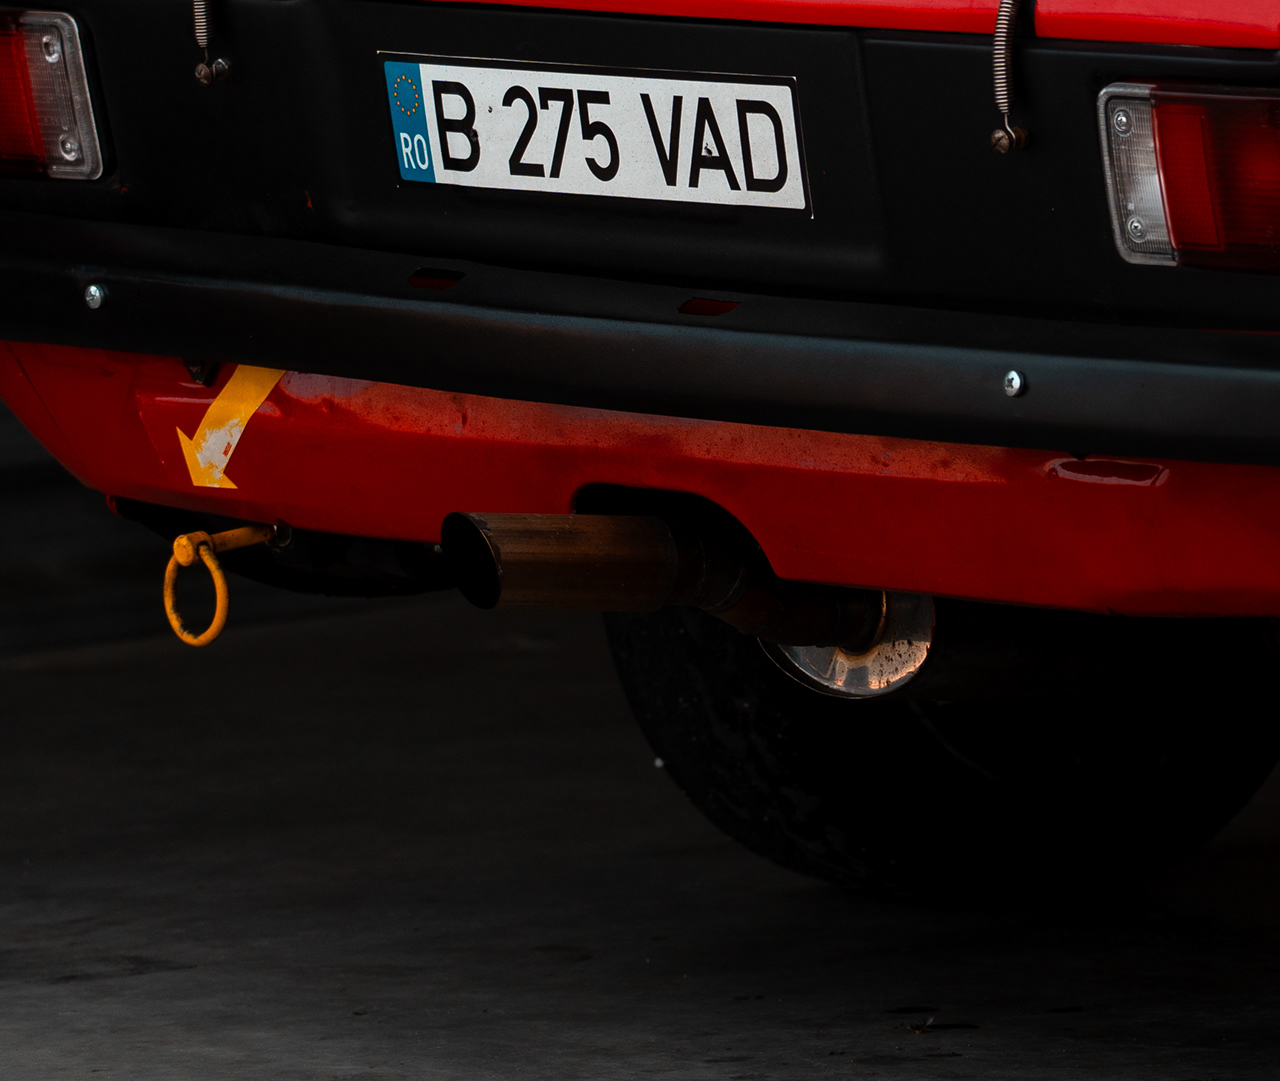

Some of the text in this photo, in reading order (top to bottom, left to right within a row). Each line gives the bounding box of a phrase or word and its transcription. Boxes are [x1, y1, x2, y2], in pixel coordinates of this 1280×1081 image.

[400, 132, 429, 170] RO
[431, 80, 788, 193] B 275 VAD
